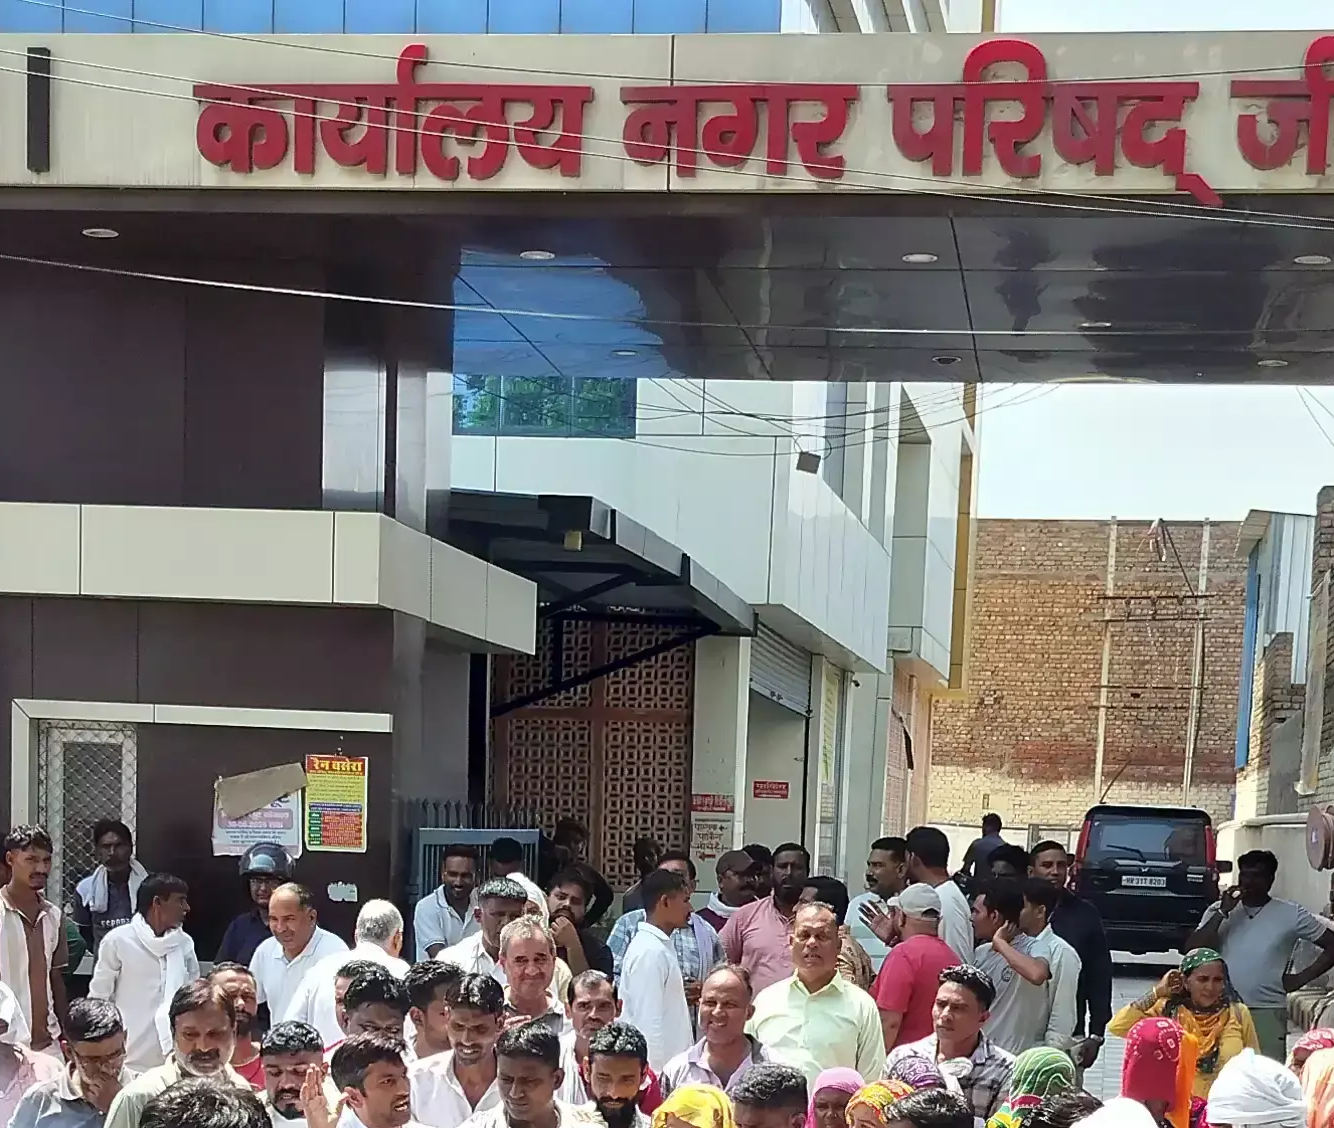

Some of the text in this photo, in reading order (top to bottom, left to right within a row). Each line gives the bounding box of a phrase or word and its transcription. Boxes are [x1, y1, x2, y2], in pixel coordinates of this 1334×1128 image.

[193, 43, 595, 181] कार्यालय
[620, 84, 859, 180] नगर
[887, 39, 1225, 209] परिषद्
